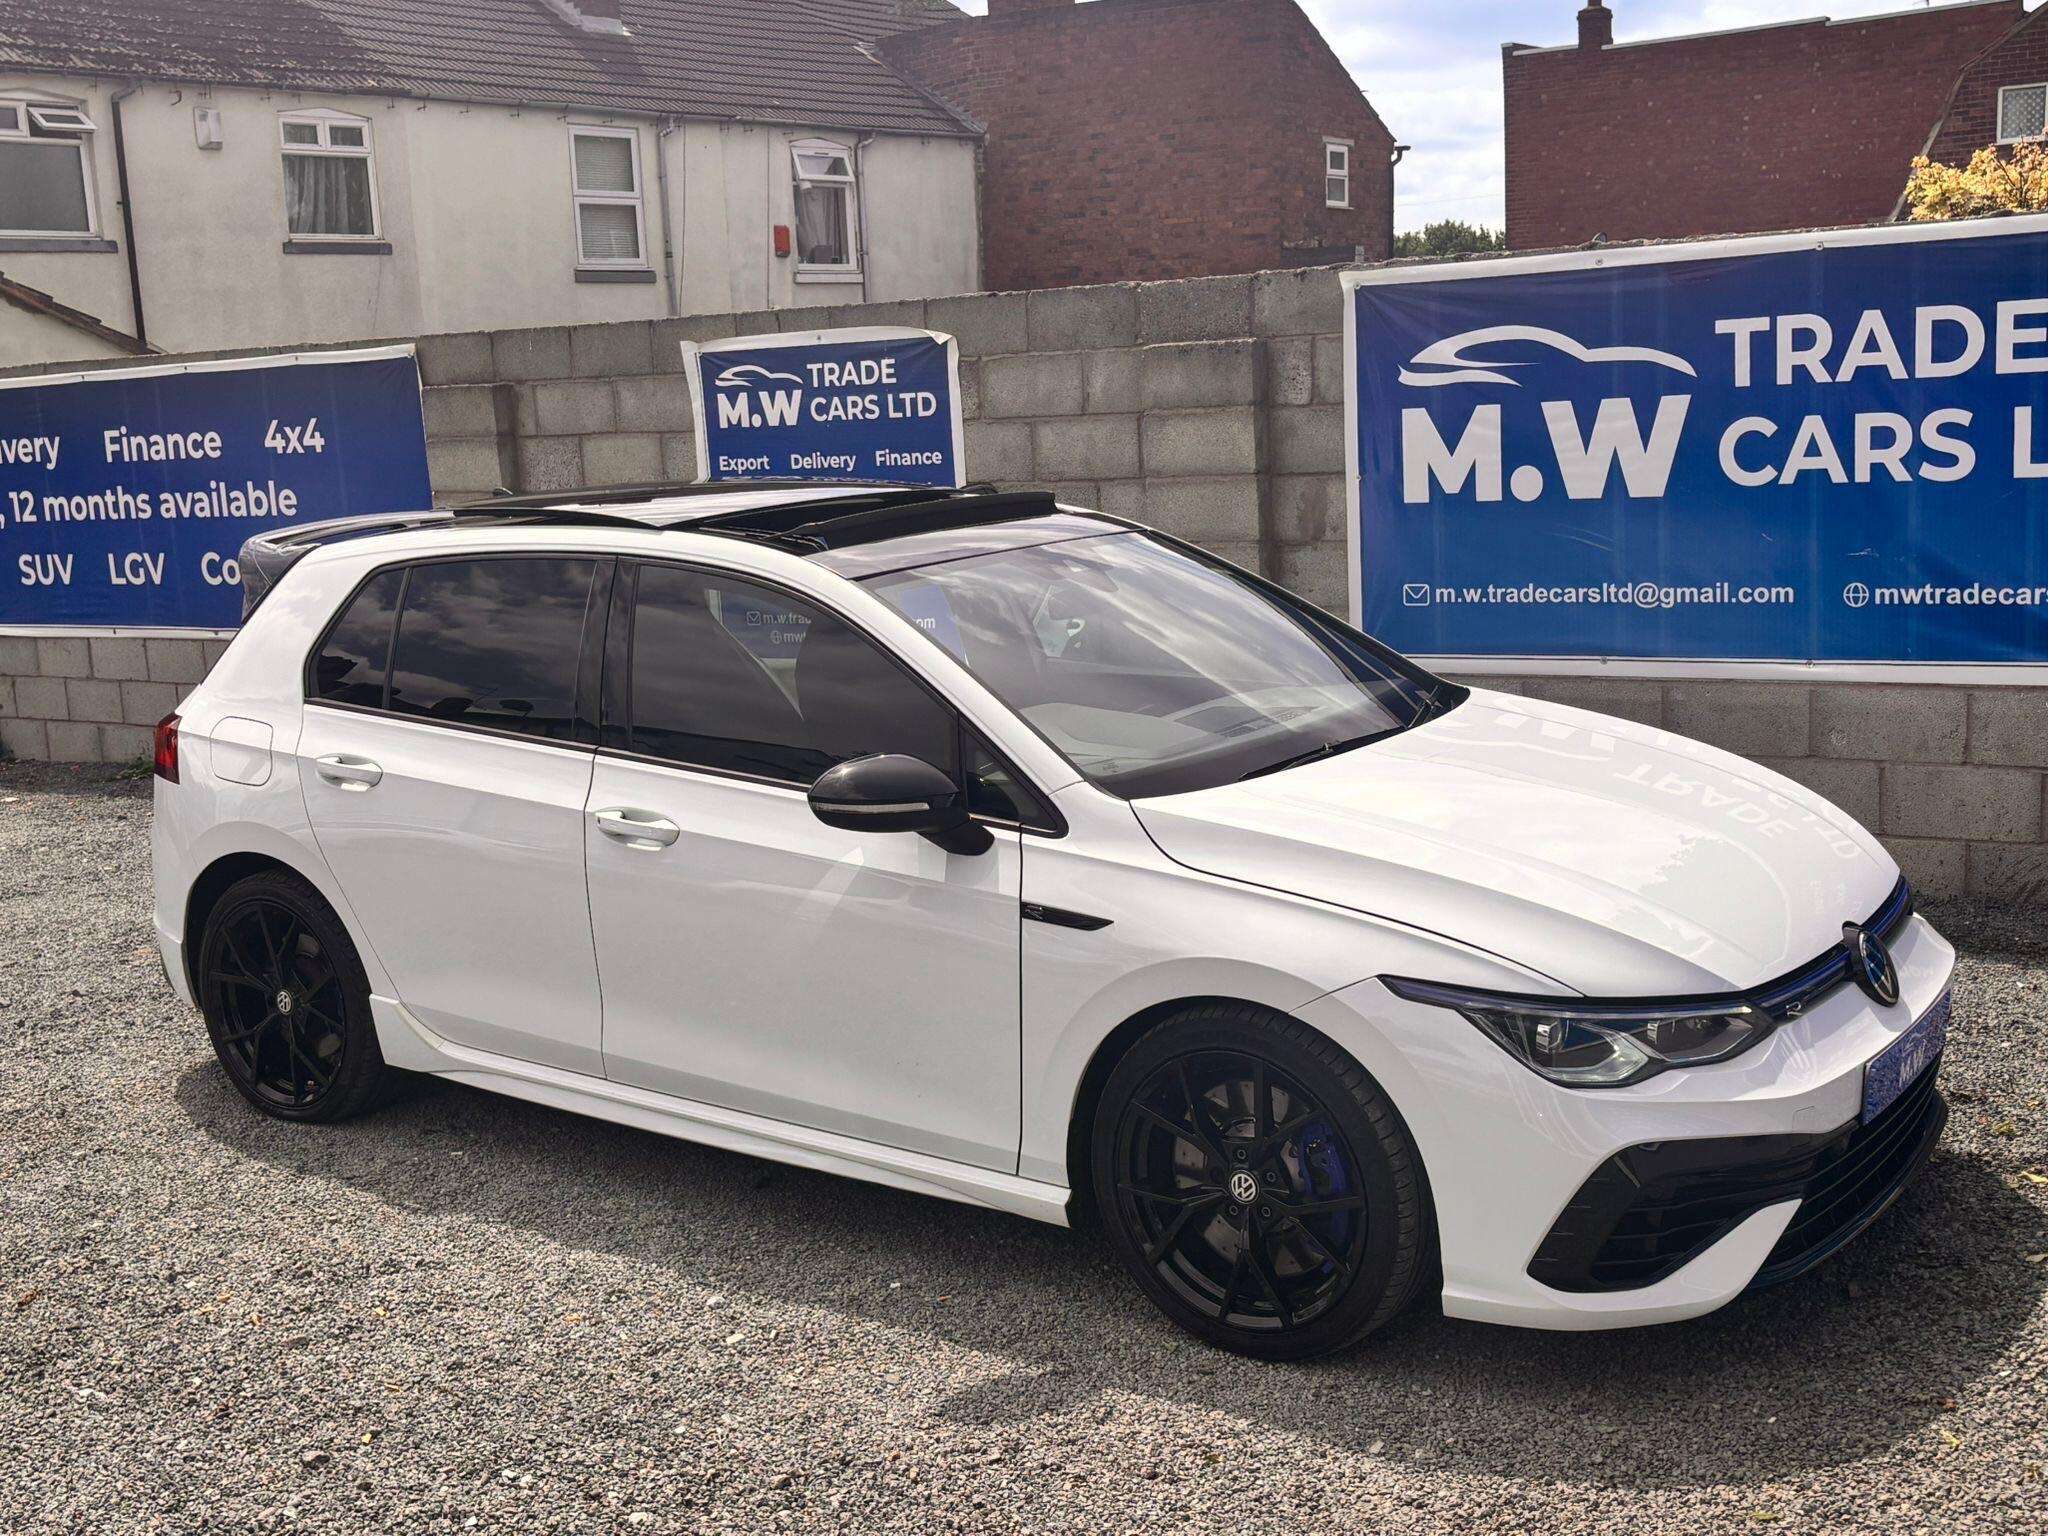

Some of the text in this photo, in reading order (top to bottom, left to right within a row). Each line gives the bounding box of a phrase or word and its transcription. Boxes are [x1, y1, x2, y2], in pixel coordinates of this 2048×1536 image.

[1715, 298, 2048, 388] TRADE
[807, 358, 897, 388] TRADE
[717, 389, 802, 429] M.W
[810, 391, 937, 422] CARS LTD
[104, 425, 222, 463] Finance
[264, 417, 325, 454] 4x4
[1402, 394, 1692, 504] M.W
[1718, 408, 1976, 487] CARS
[719, 448, 942, 474] Export Delivery Finance
[9, 490, 37, 523] 12
[43, 485, 152, 522] months
[160, 480, 297, 519] available
[18, 553, 73, 586] SUV
[108, 552, 165, 586] LGV
[1435, 582, 1794, 608] m.w.tradecarsltd@gmail.com
[1875, 582, 2048, 605] mwtradecar
